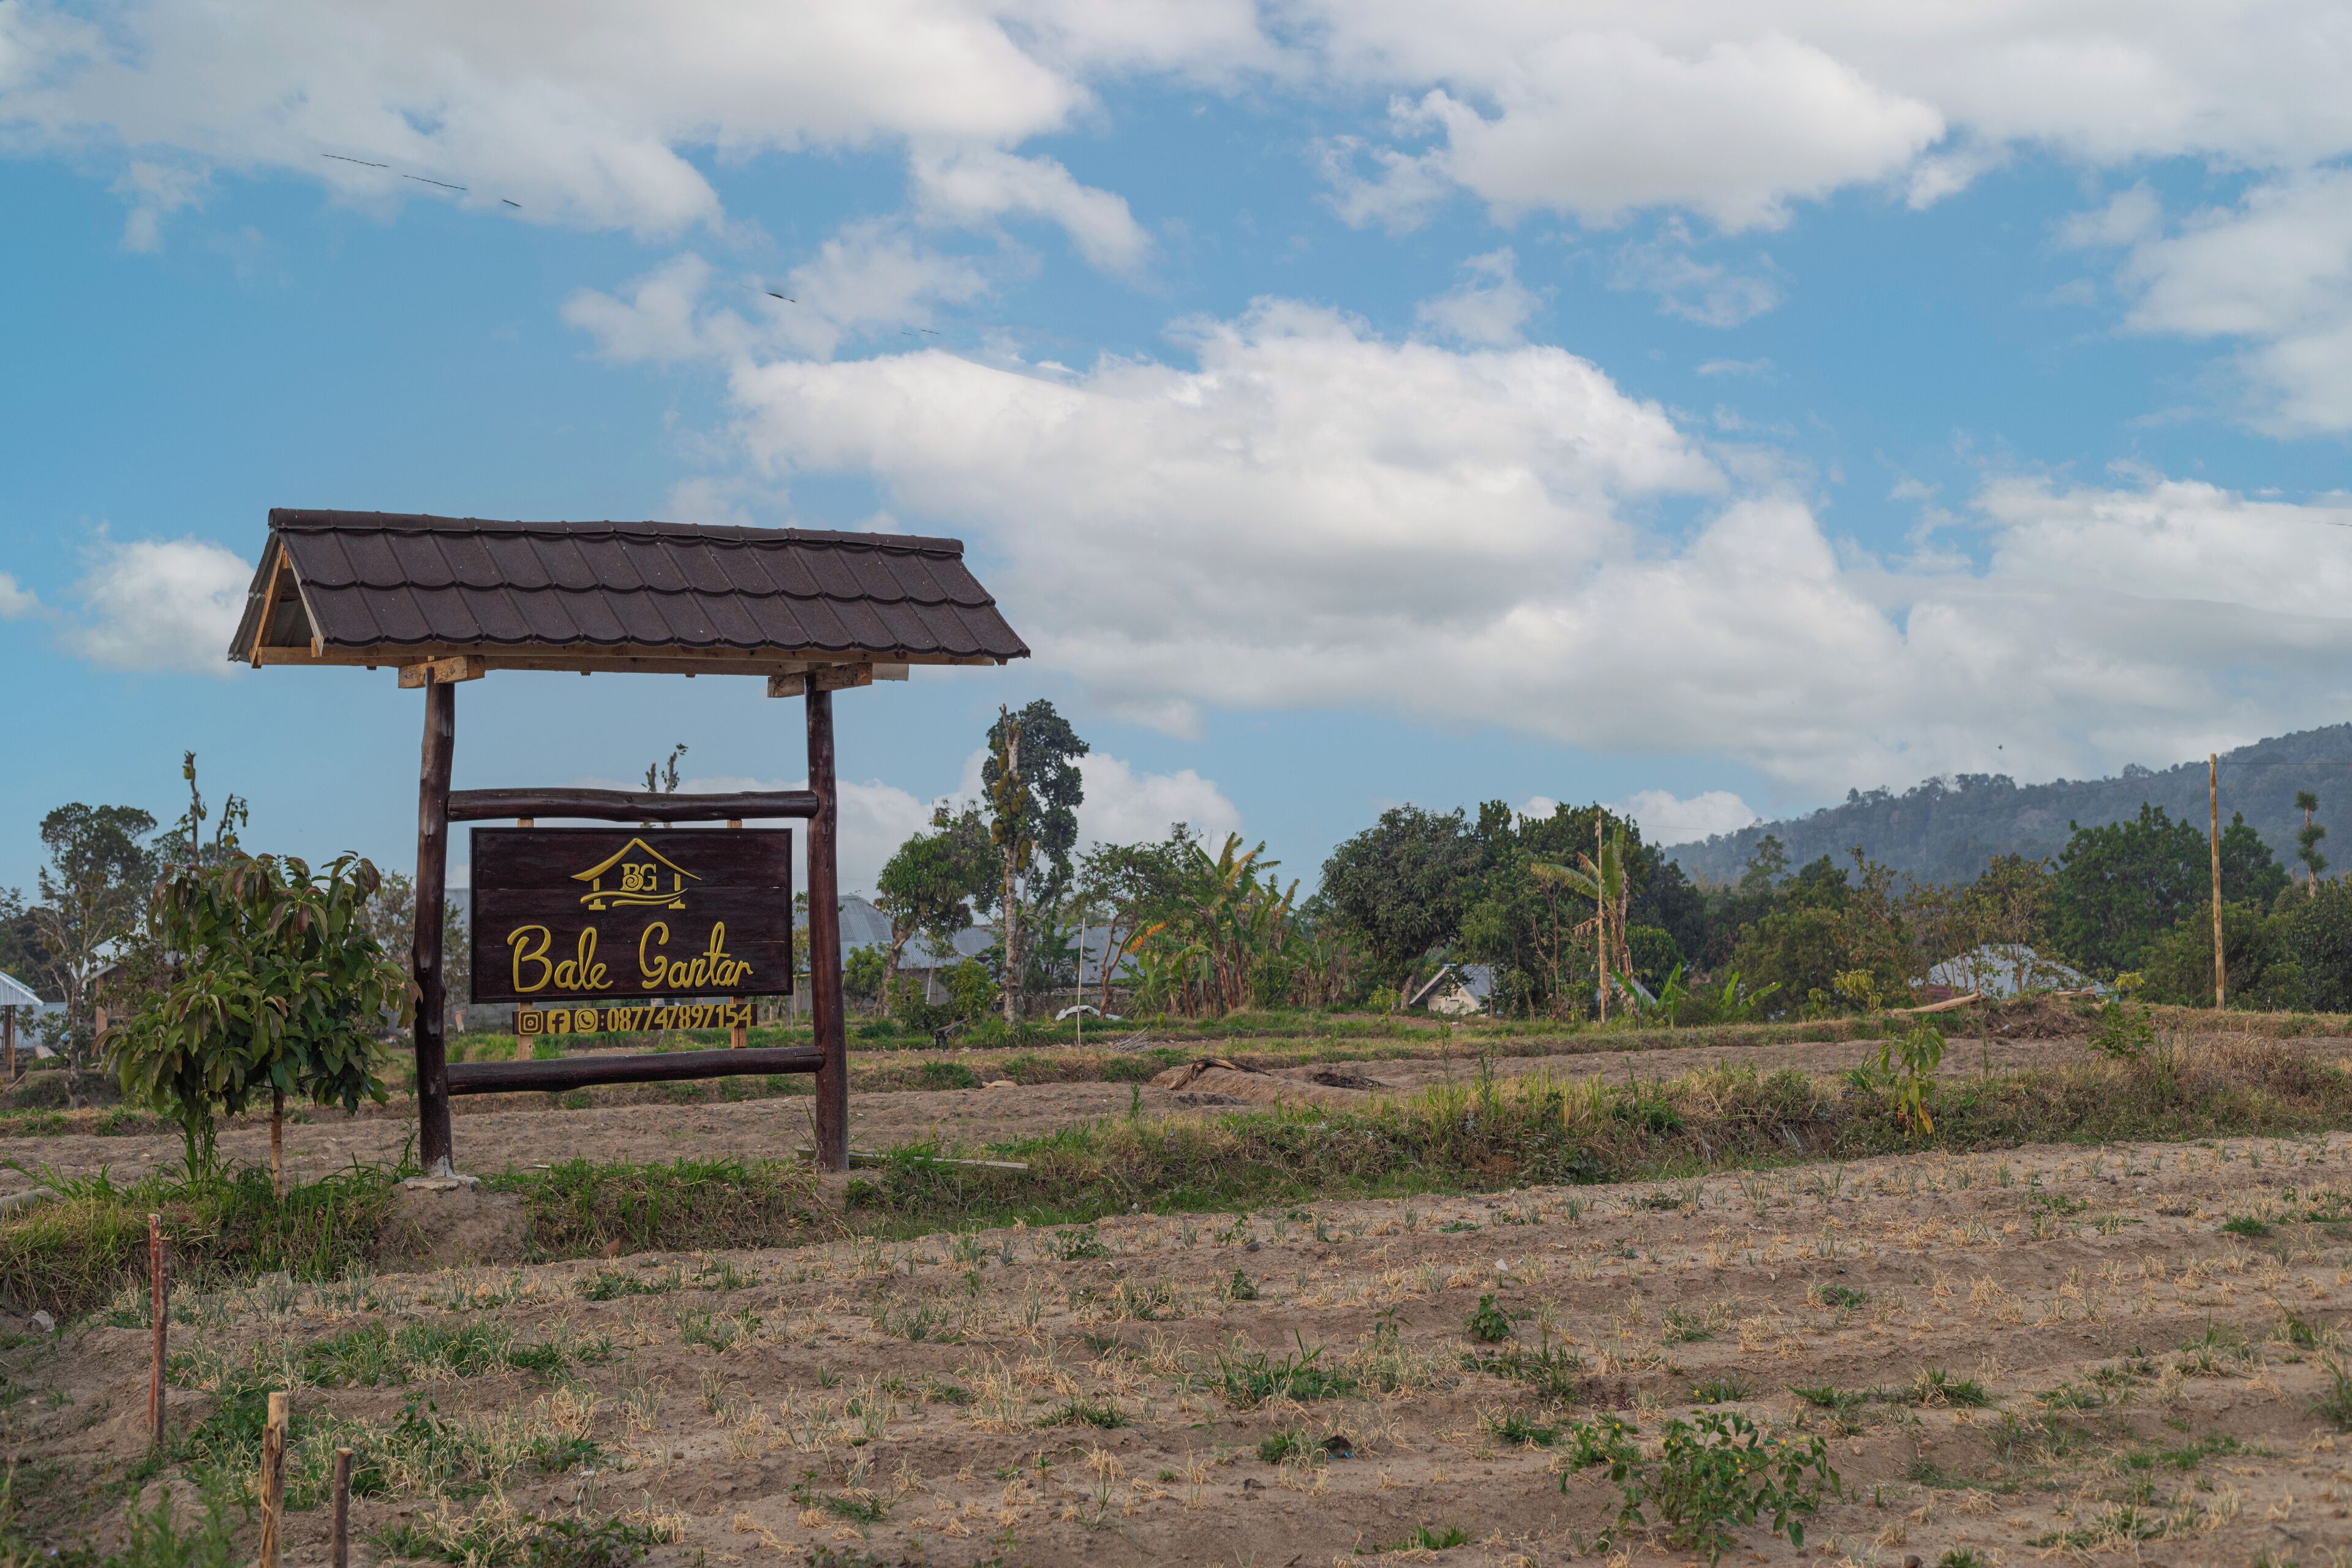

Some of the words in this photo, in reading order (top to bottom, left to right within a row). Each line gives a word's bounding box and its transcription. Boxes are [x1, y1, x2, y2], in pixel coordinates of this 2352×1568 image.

[621, 863, 657, 892] BG
[507, 925, 614, 992] Bale
[639, 922, 754, 989] Gantar
